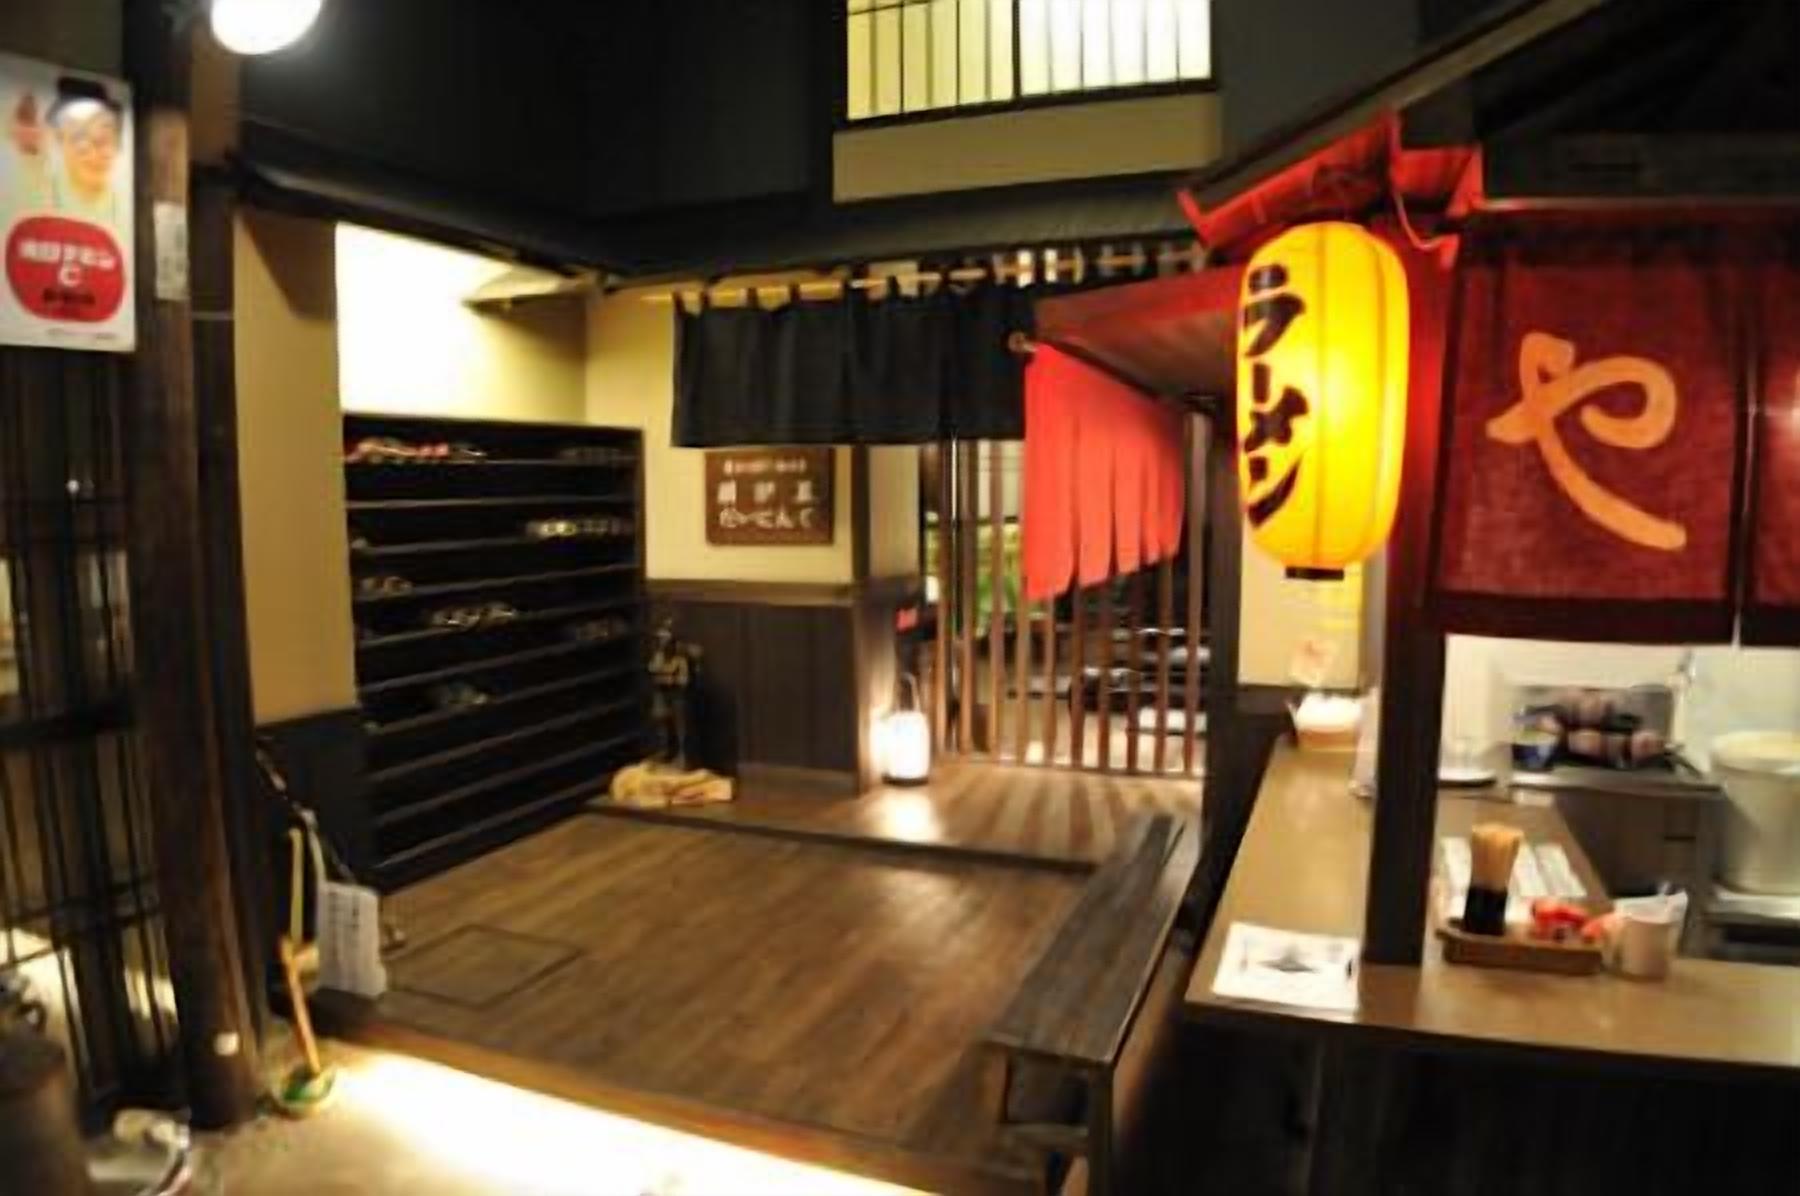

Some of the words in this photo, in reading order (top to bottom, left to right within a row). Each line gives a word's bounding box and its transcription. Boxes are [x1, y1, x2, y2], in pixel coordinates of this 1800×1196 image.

[1244, 263, 1309, 529] ラーメン
[1485, 331, 1687, 550] や
